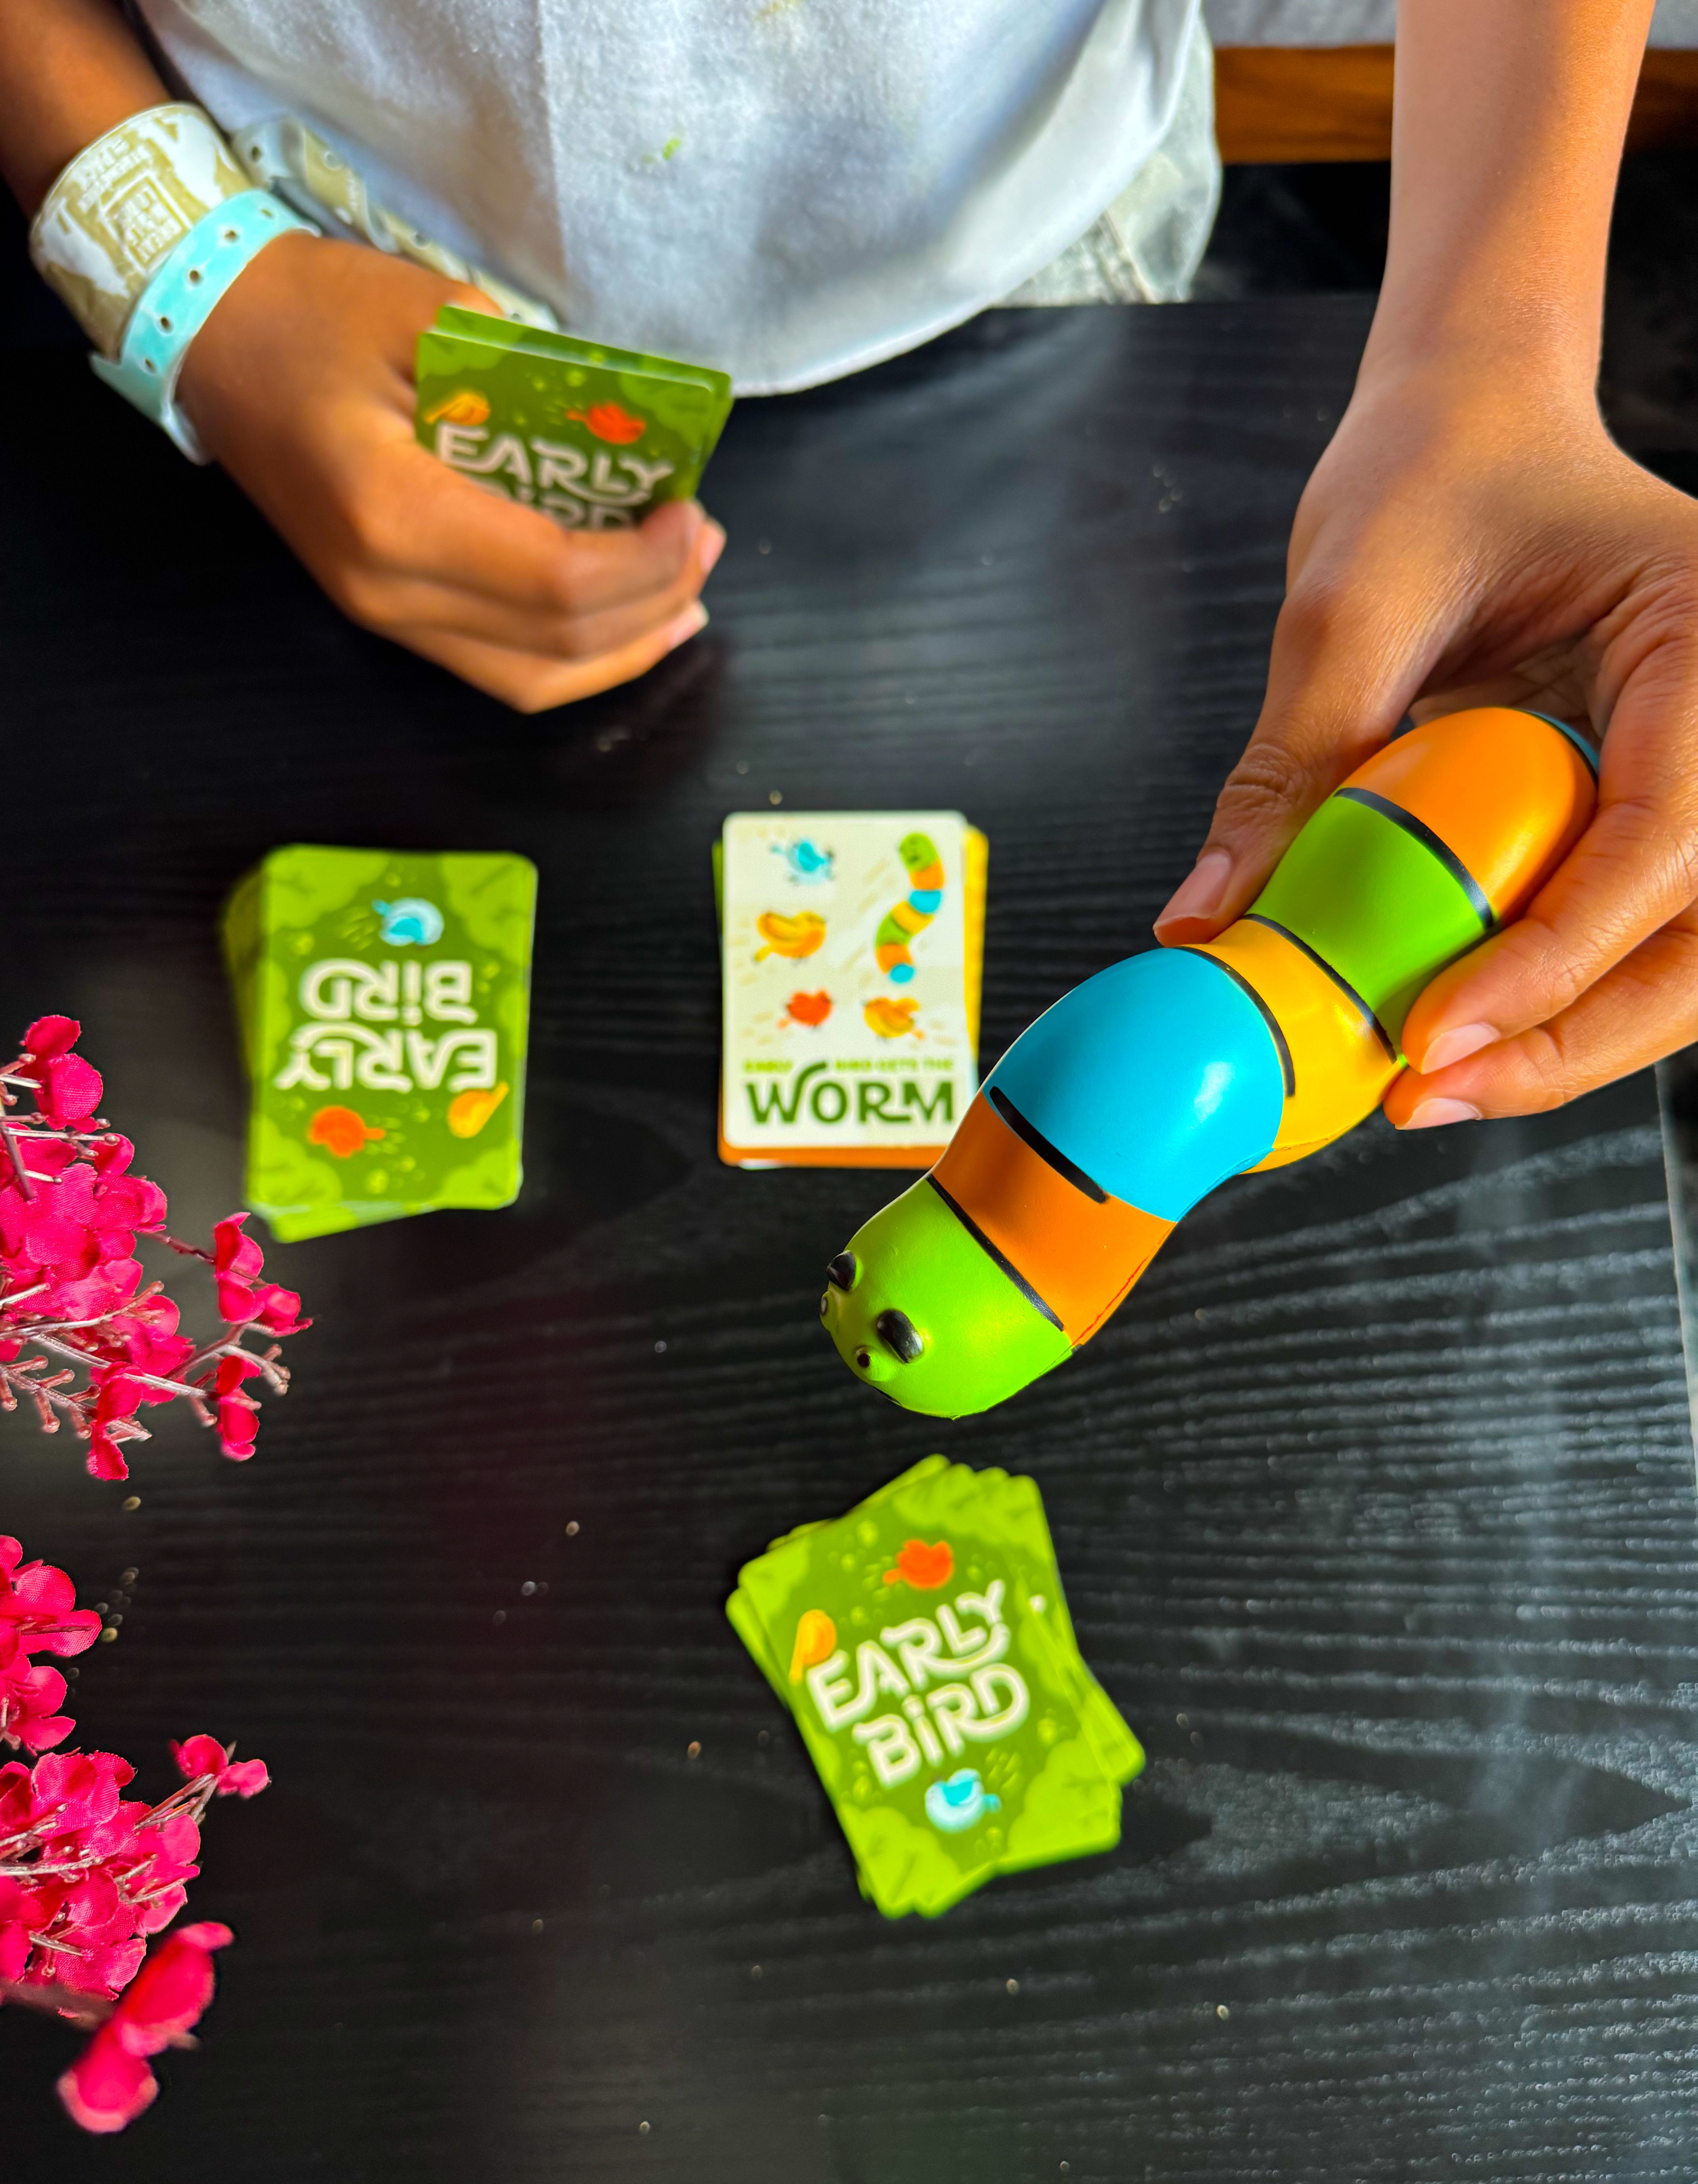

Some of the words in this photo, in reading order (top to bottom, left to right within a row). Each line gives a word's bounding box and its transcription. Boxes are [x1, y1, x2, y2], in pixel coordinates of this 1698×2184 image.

[436, 421, 675, 506] EARLY
[274, 1021, 498, 1093] EARLY
[746, 1060, 953, 1123] WORM
[805, 1579, 1011, 1733] EARLY
